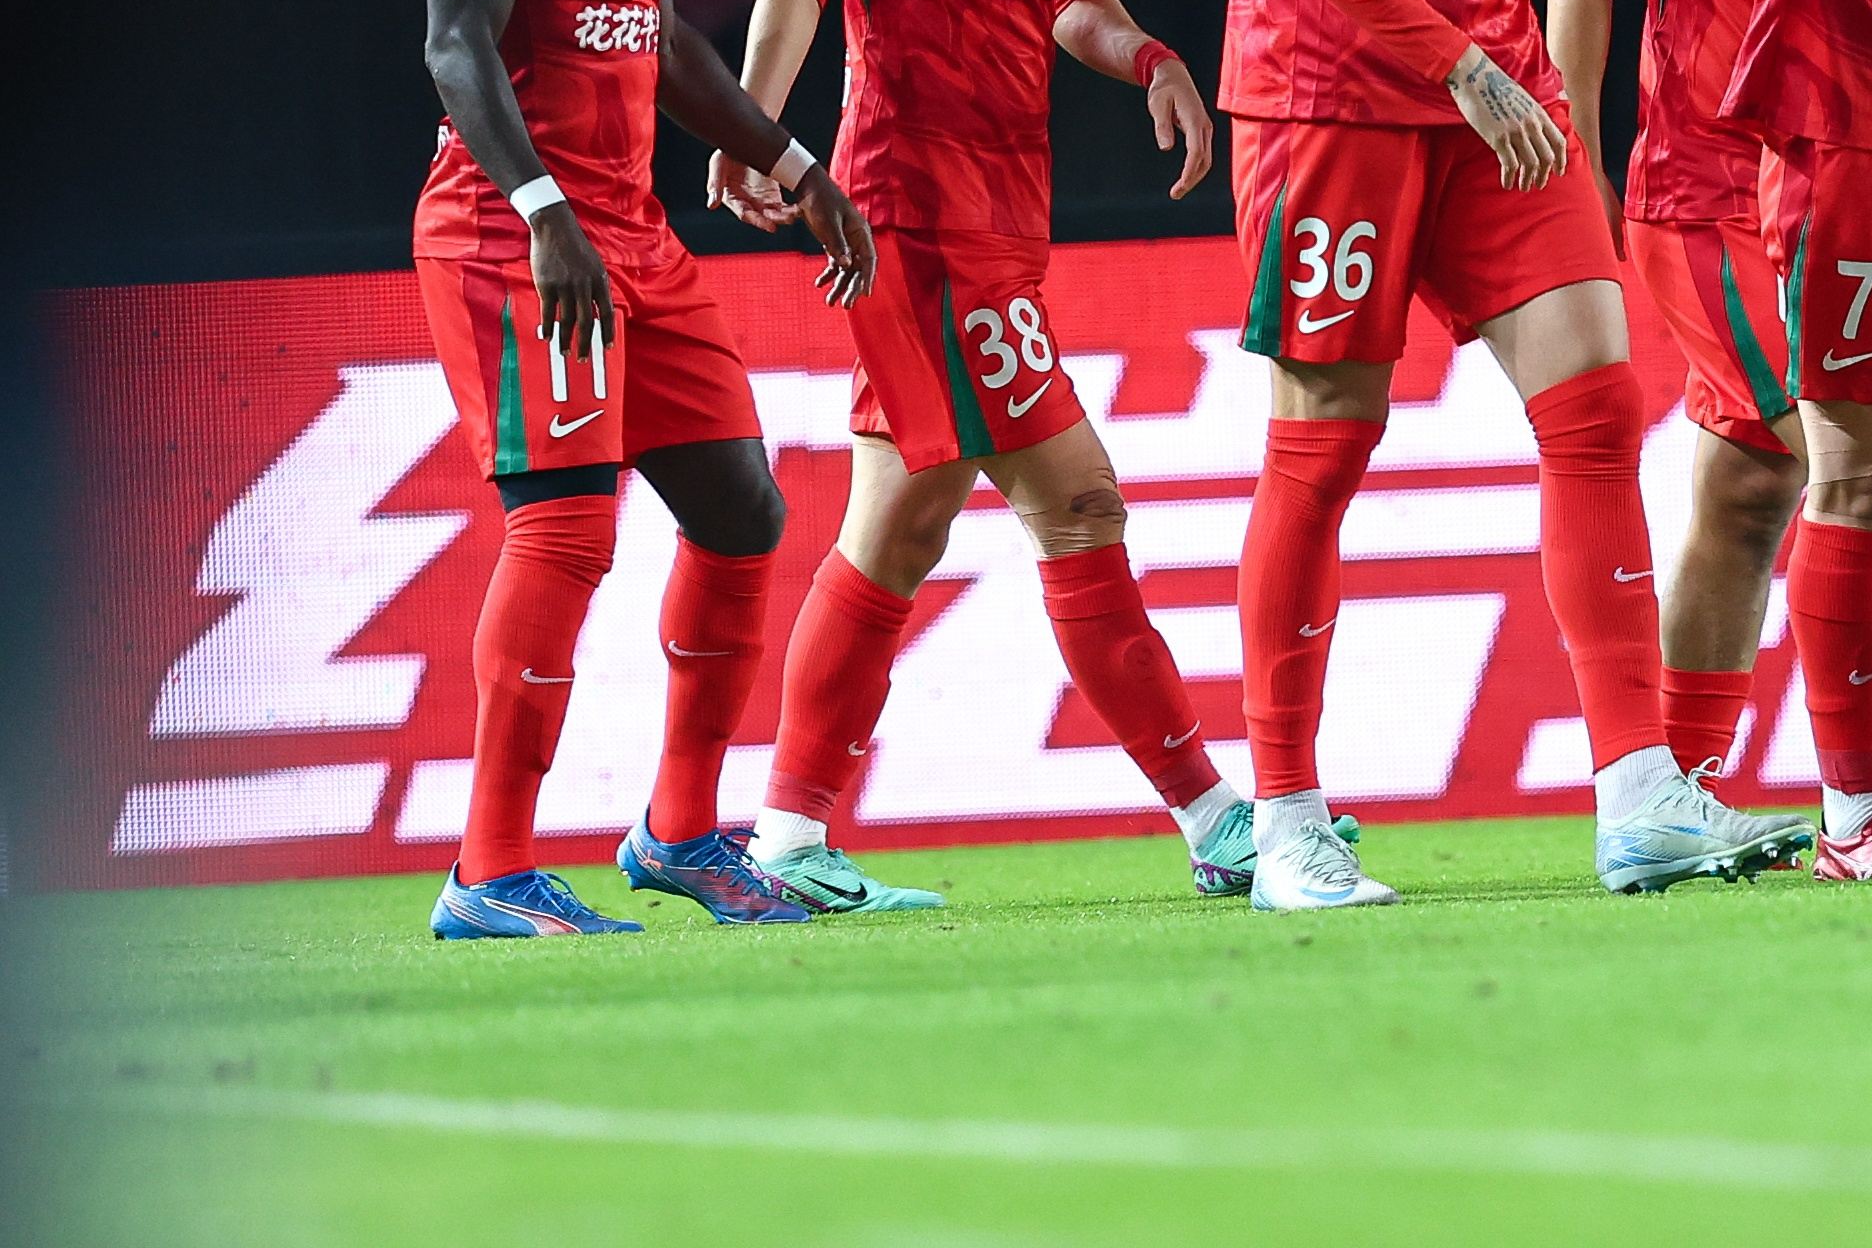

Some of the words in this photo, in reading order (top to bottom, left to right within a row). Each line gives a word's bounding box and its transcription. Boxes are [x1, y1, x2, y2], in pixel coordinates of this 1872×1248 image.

[1291, 216, 1377, 301] 36
[537, 319, 607, 403] 11
[963, 297, 1054, 390] 38
